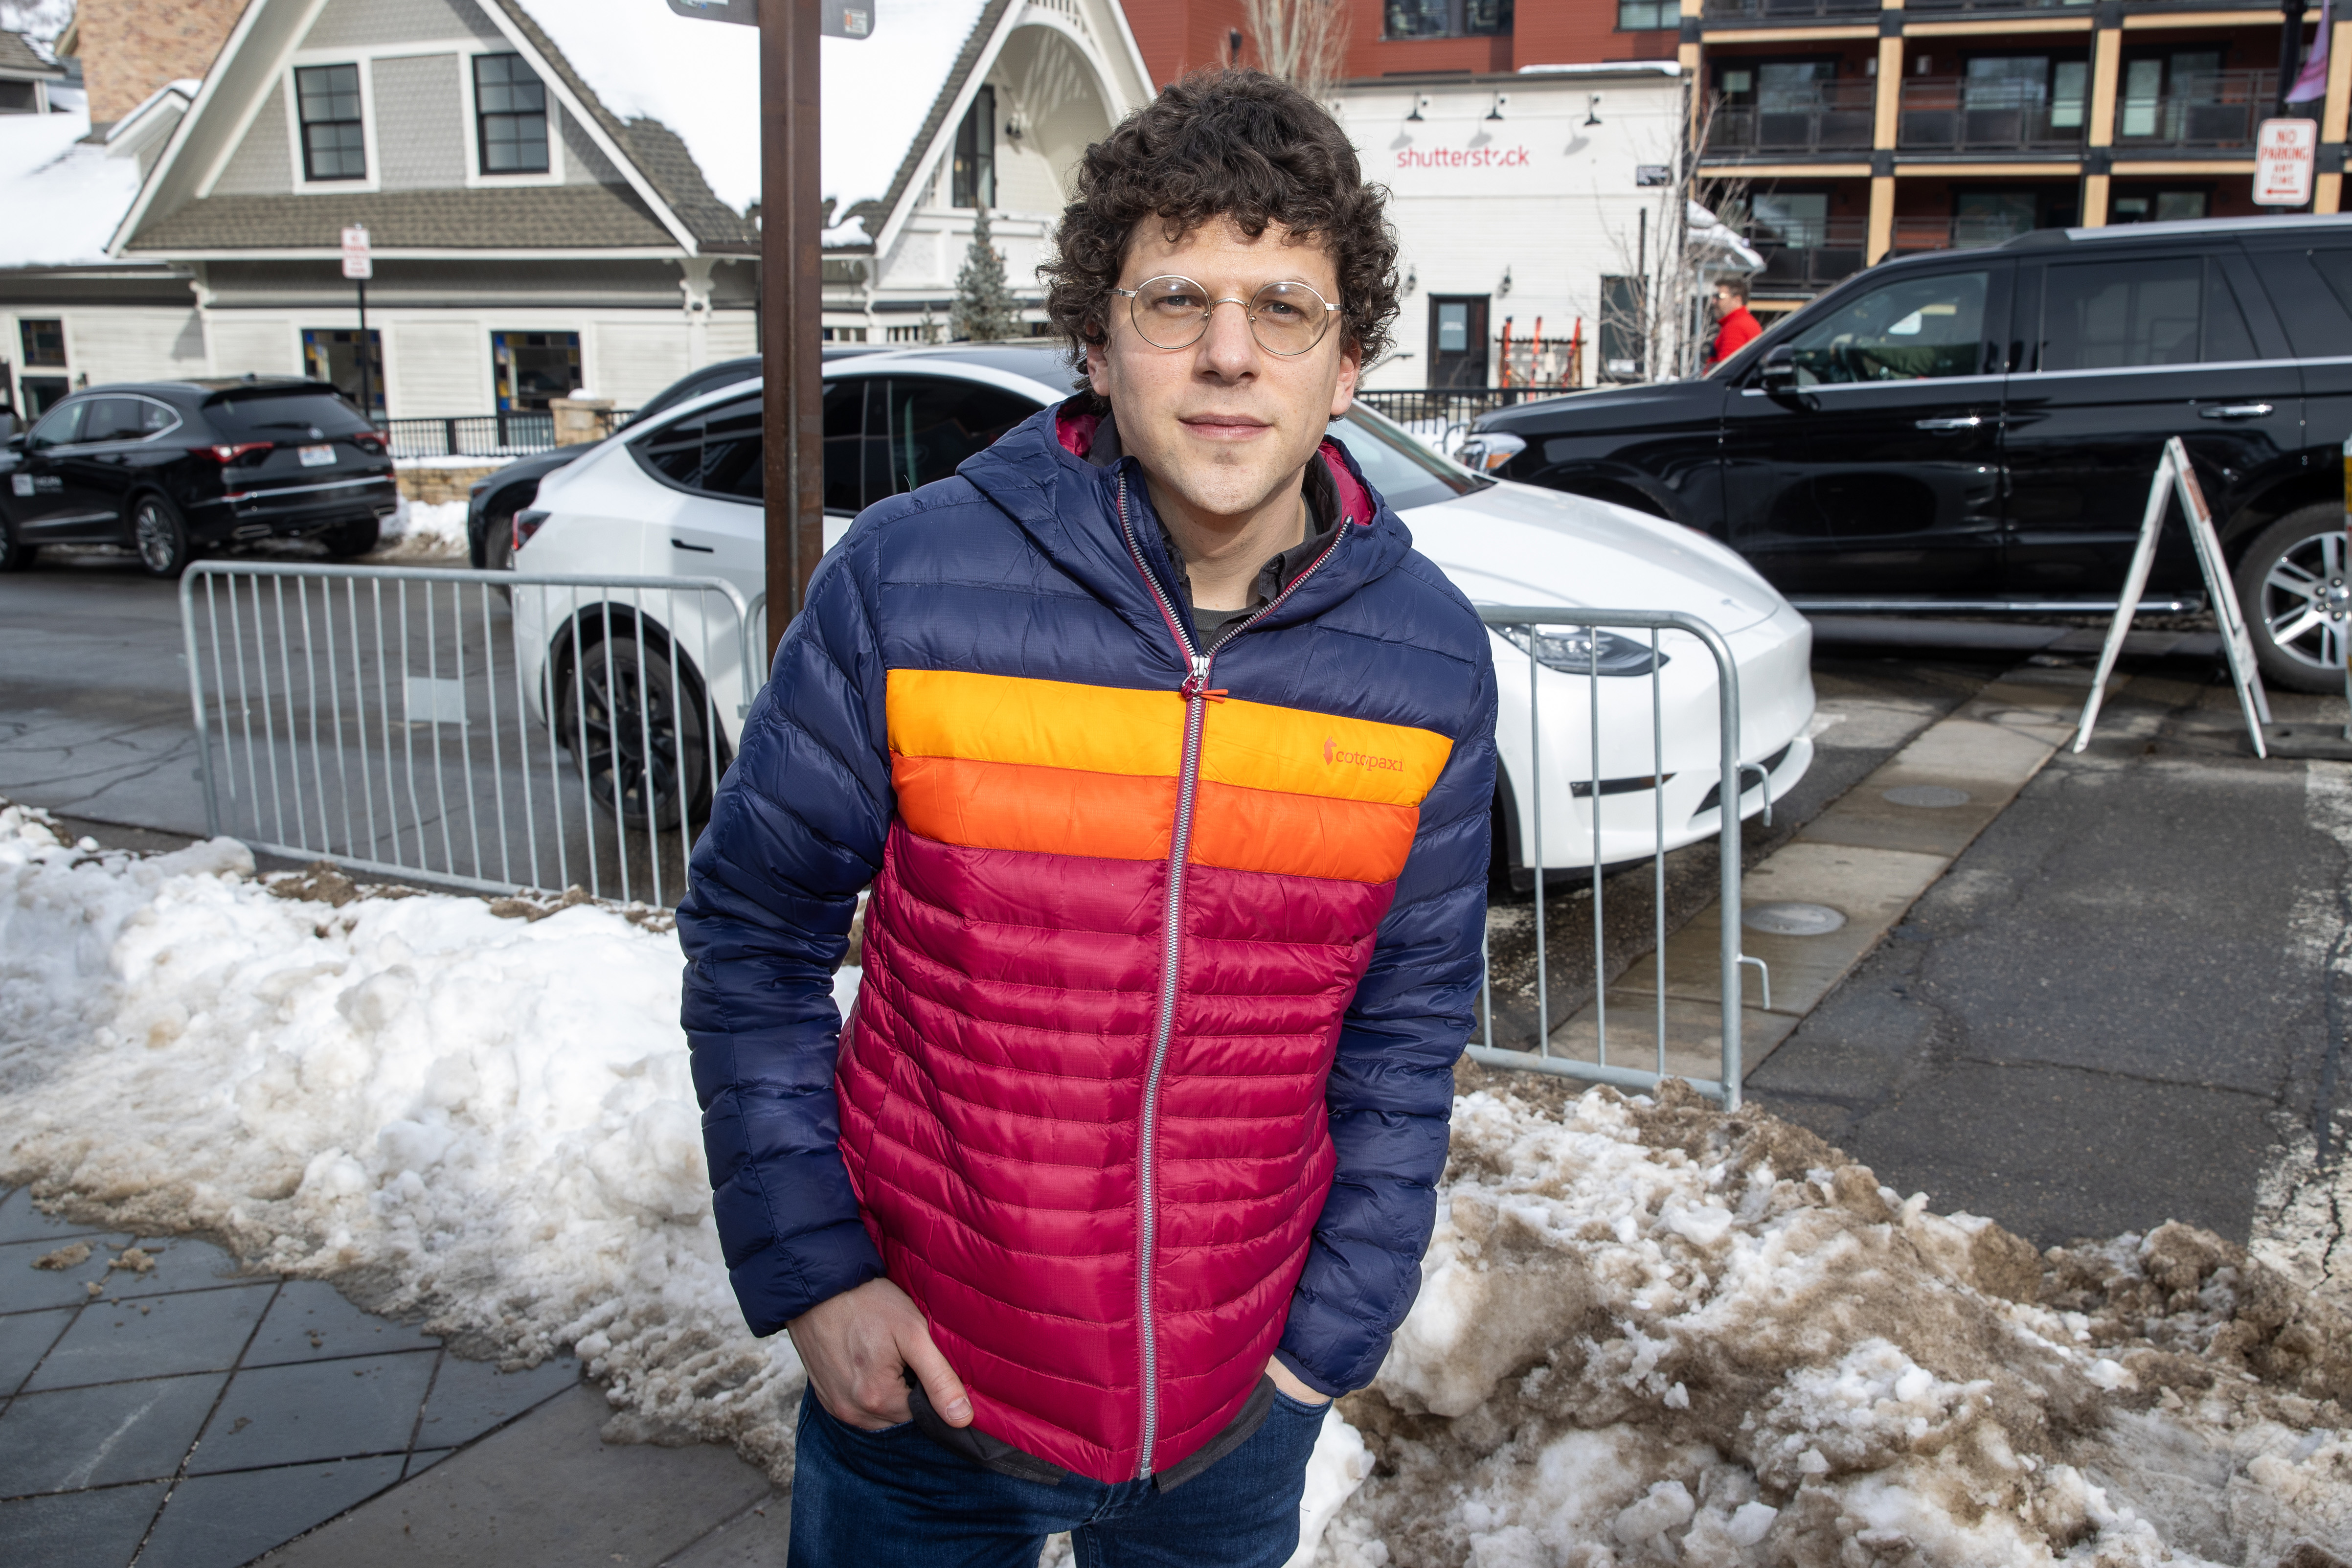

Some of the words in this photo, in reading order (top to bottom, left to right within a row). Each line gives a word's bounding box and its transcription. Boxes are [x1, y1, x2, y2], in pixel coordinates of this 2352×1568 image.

[2276, 130, 2298, 145] NO
[1397, 145, 1530, 167] shutterstock
[2261, 147, 2309, 161] PARKING
[2274, 164, 2294, 173] ANY
[2270, 174, 2294, 186] TIME
[1336, 751, 1403, 772] cotopaxi
